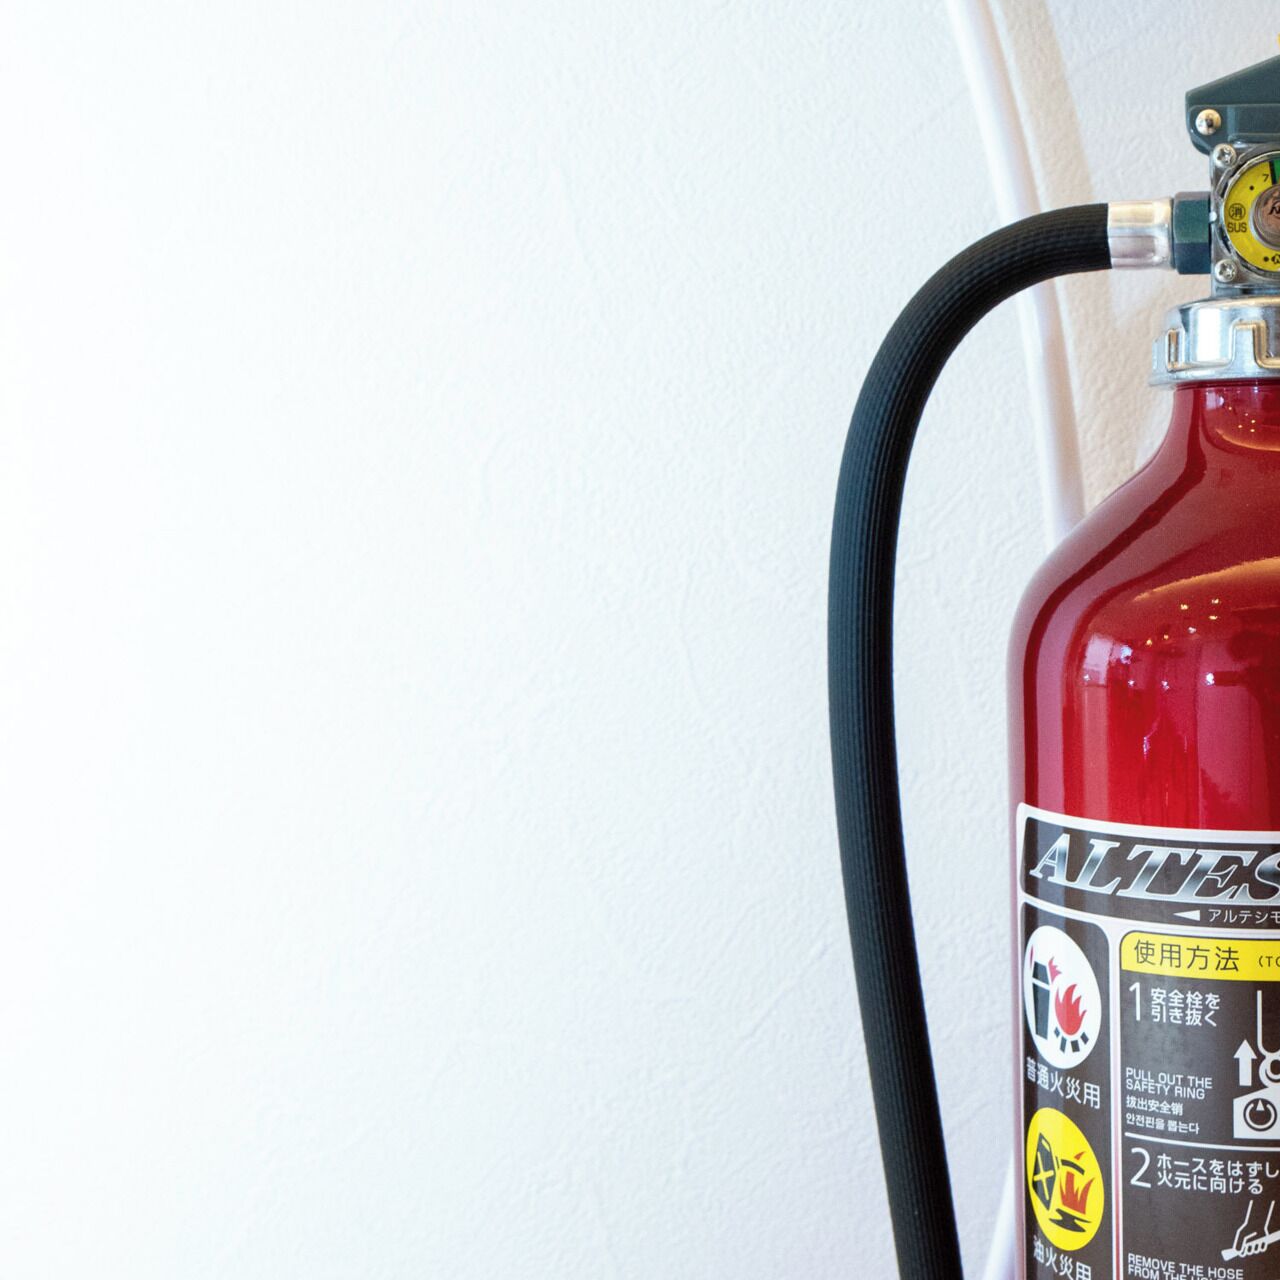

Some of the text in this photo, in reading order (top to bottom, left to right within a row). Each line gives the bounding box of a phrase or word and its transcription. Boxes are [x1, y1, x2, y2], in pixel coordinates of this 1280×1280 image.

[1262, 173, 1269, 182] 7
[1227, 222, 1247, 233] SUS
[1134, 939, 1239, 972] 使用方法
[1128, 982, 1141, 1021] 1
[1151, 987, 1220, 1010] 安全栓を
[1151, 1006, 1217, 1027] 引き抜く
[1026, 1056, 1101, 1109] 普通火災用
[1126, 1068, 1212, 1090] PULL OUT THE
[1126, 1079, 1205, 1100] SAFETY RING
[1130, 1147, 1151, 1188] 2
[1157, 1153, 1279, 1178] ホースをはずし
[1157, 1171, 1263, 1195] 火元に向ける
[1128, 1253, 1244, 1280] REMOVE THE HOSE
[1128, 1264, 1161, 1280] FROM
